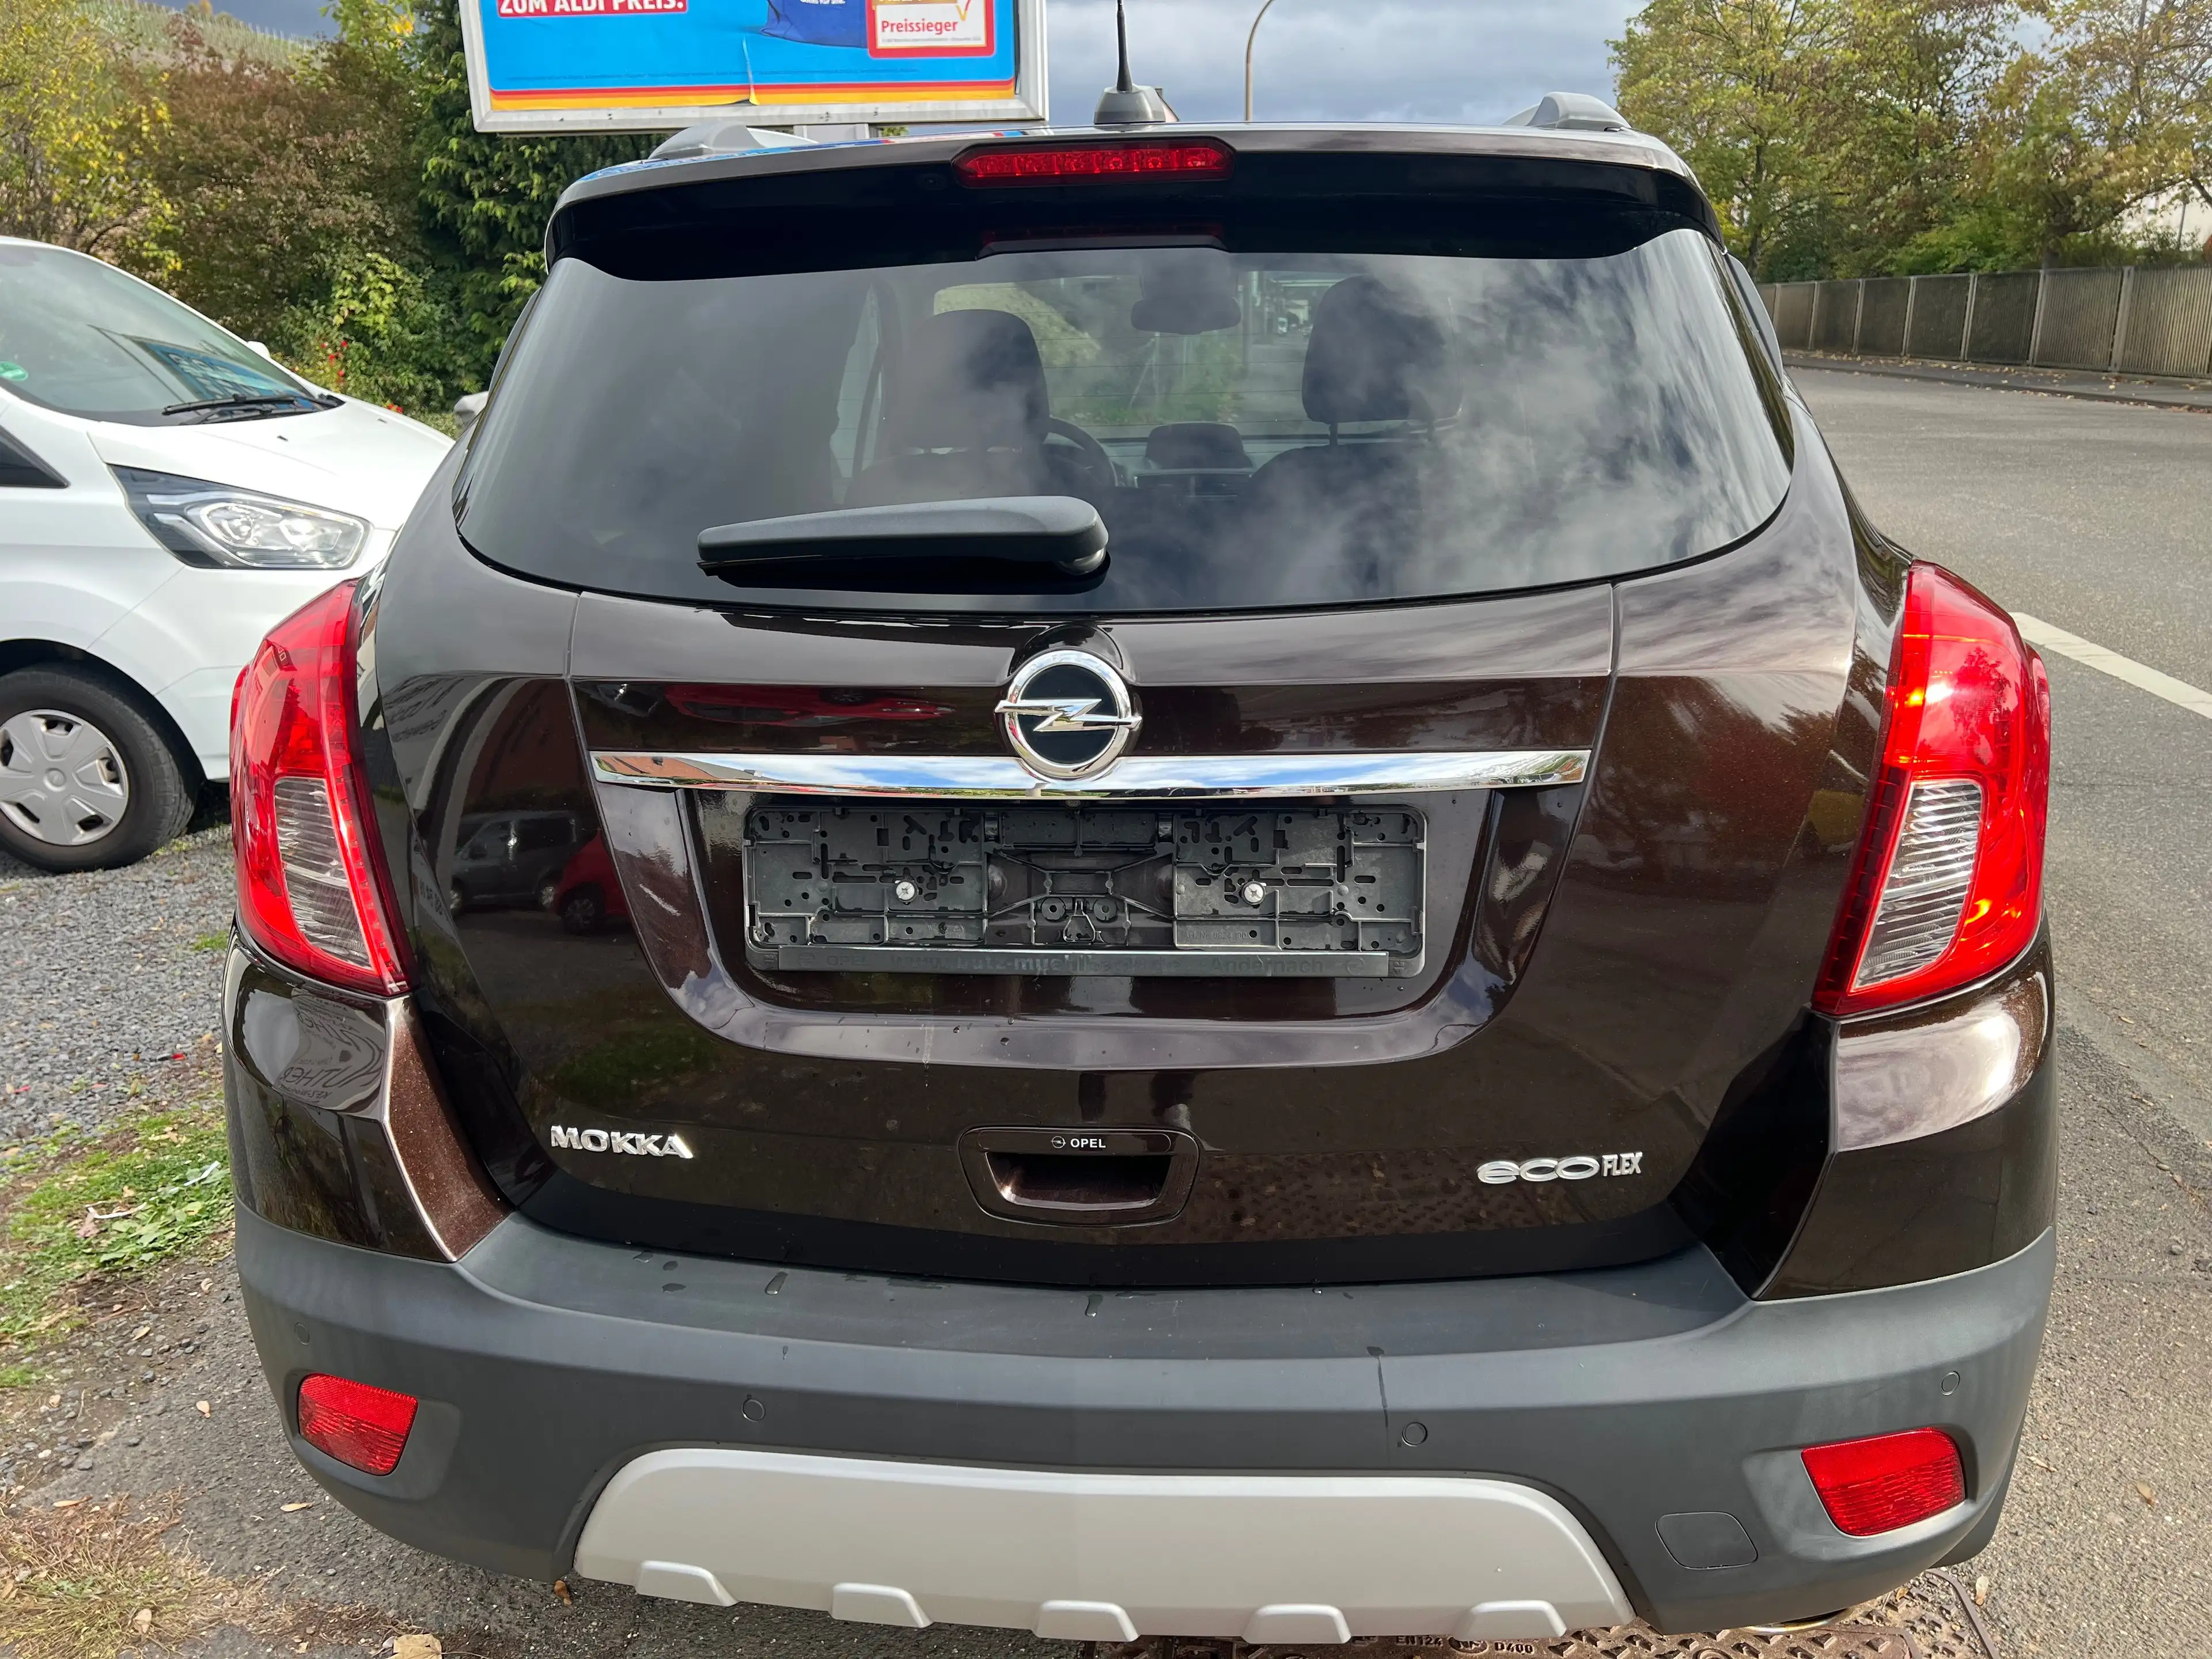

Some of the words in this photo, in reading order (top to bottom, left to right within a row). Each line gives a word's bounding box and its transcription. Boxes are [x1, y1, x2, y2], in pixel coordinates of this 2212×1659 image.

[500, 0, 548, 14] ZUM
[554, 0, 605, 12] ALDI
[881, 18, 959, 35] Preissieger
[550, 1124, 694, 1160] MOKKA
[1070, 1138, 1107, 1149] OPEL
[1493, 1641, 1535, 1656] D400
